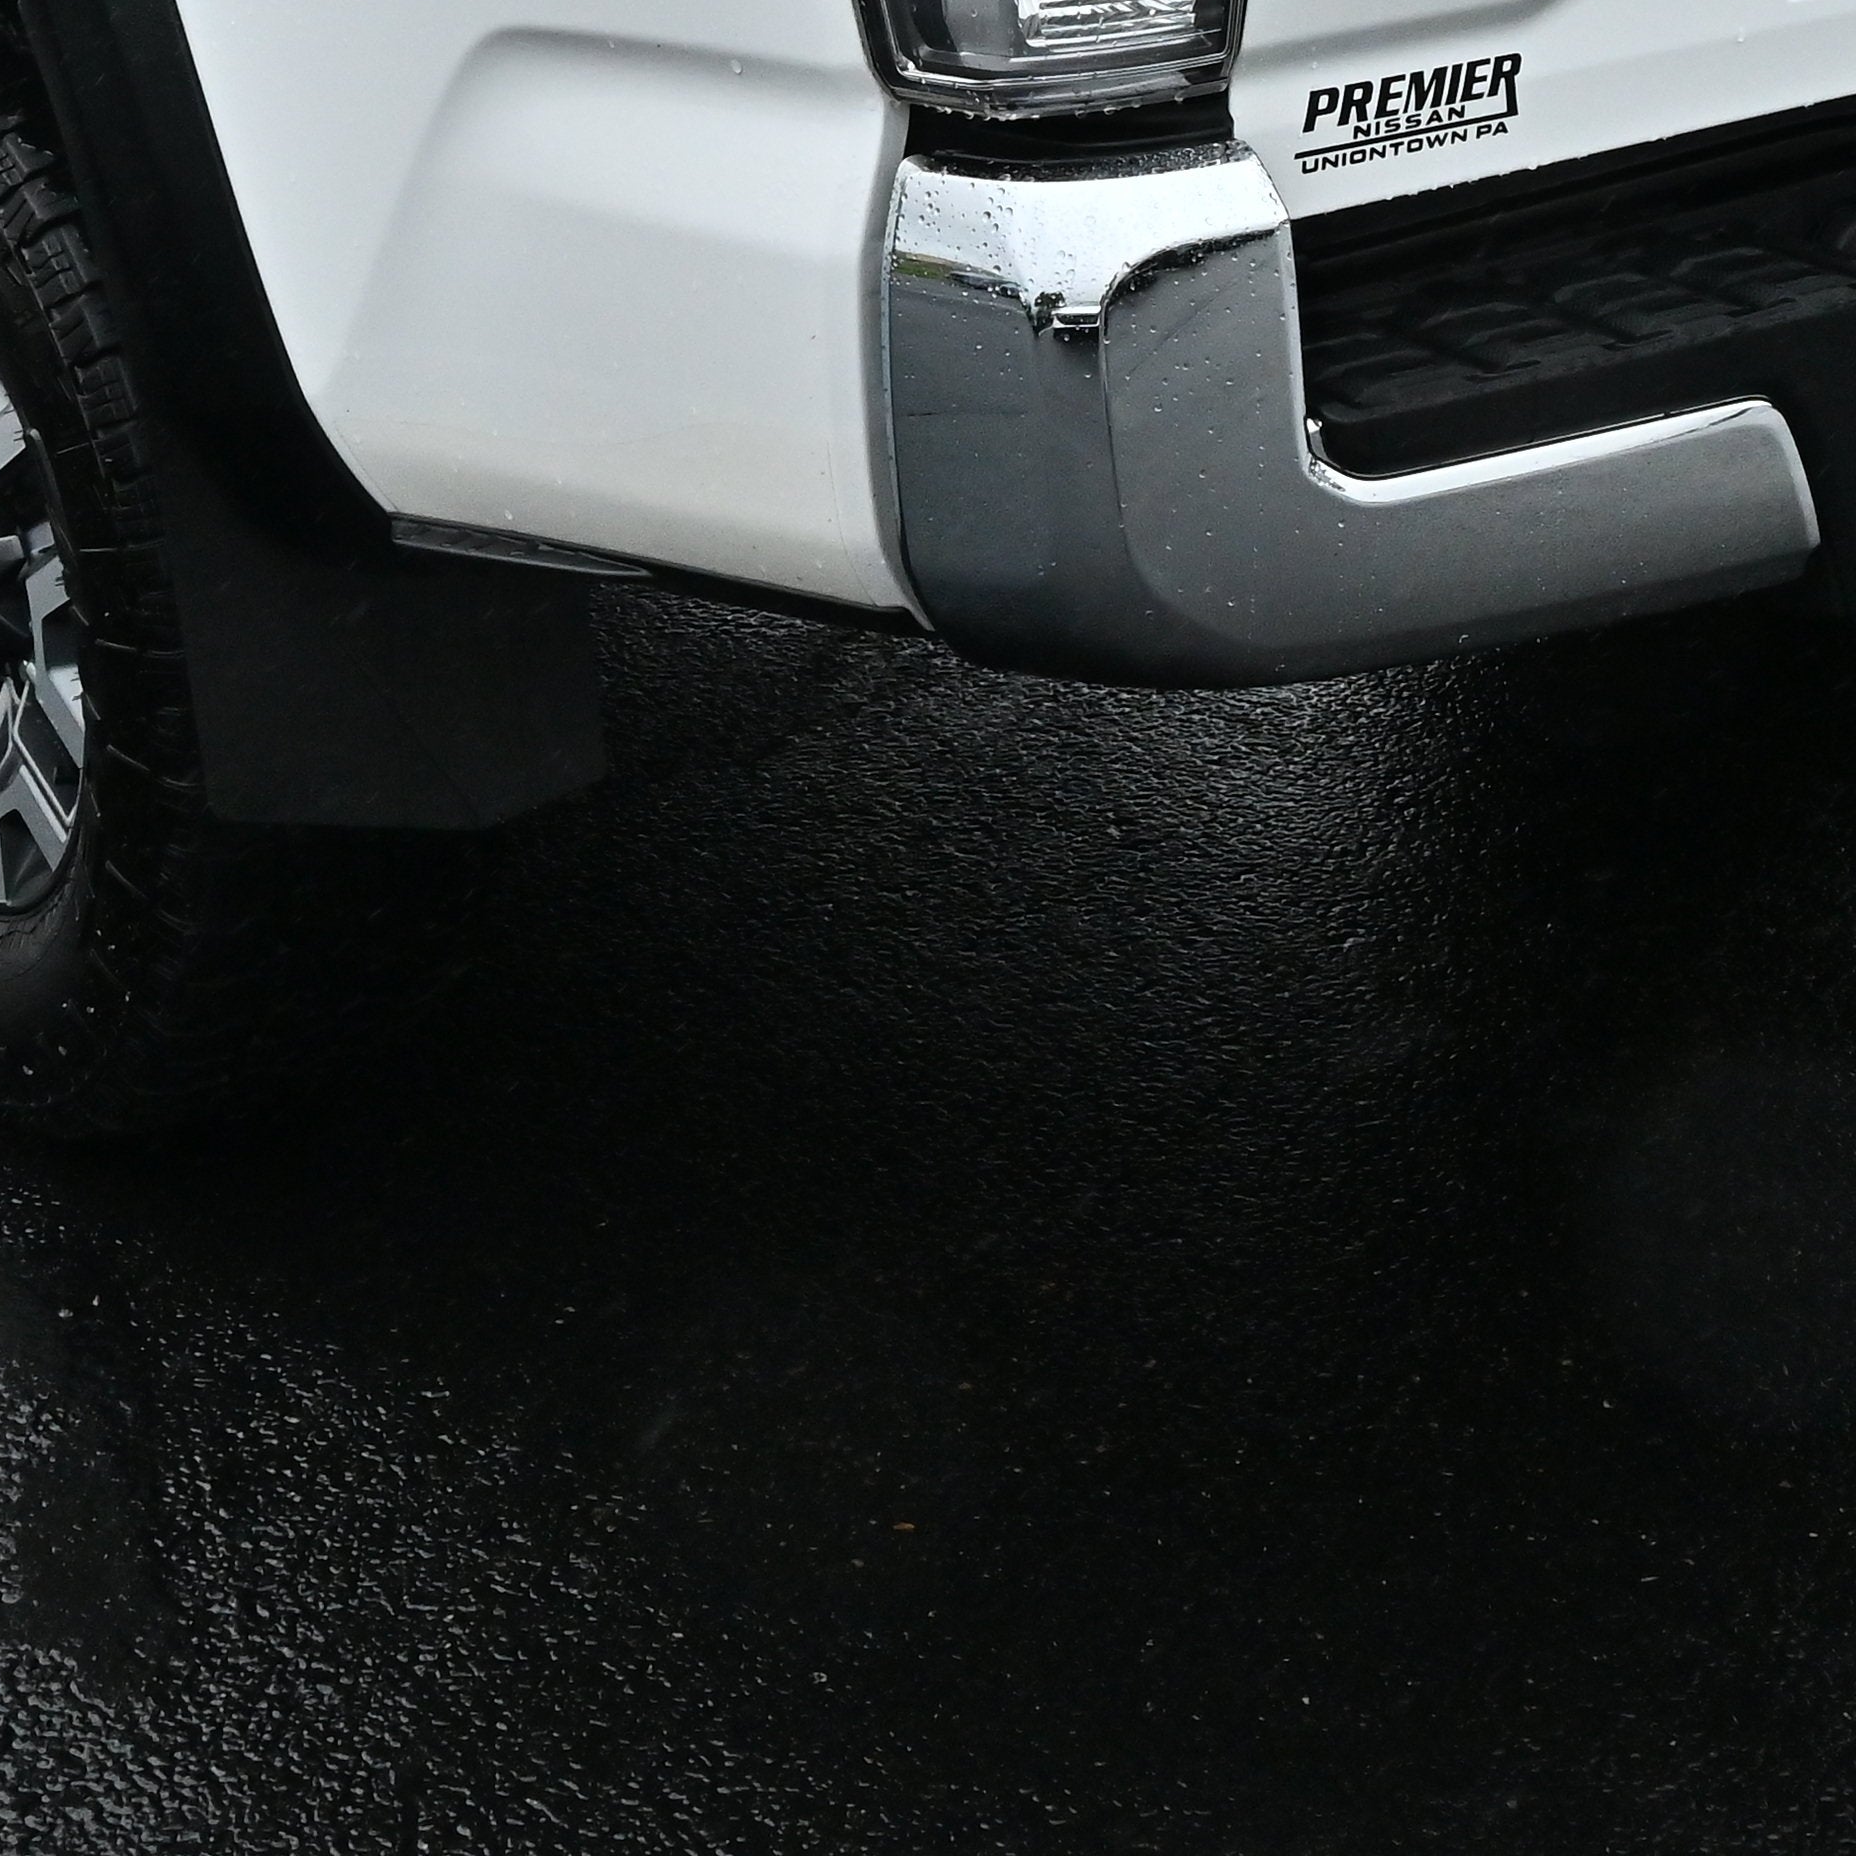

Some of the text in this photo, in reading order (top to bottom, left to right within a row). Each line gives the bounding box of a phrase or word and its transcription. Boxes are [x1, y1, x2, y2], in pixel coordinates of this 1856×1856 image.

[1302, 52, 1522, 134] PREMIER
[1301, 121, 1509, 175] UNIONTOWN PA
[1353, 105, 1466, 140] NISSAN
